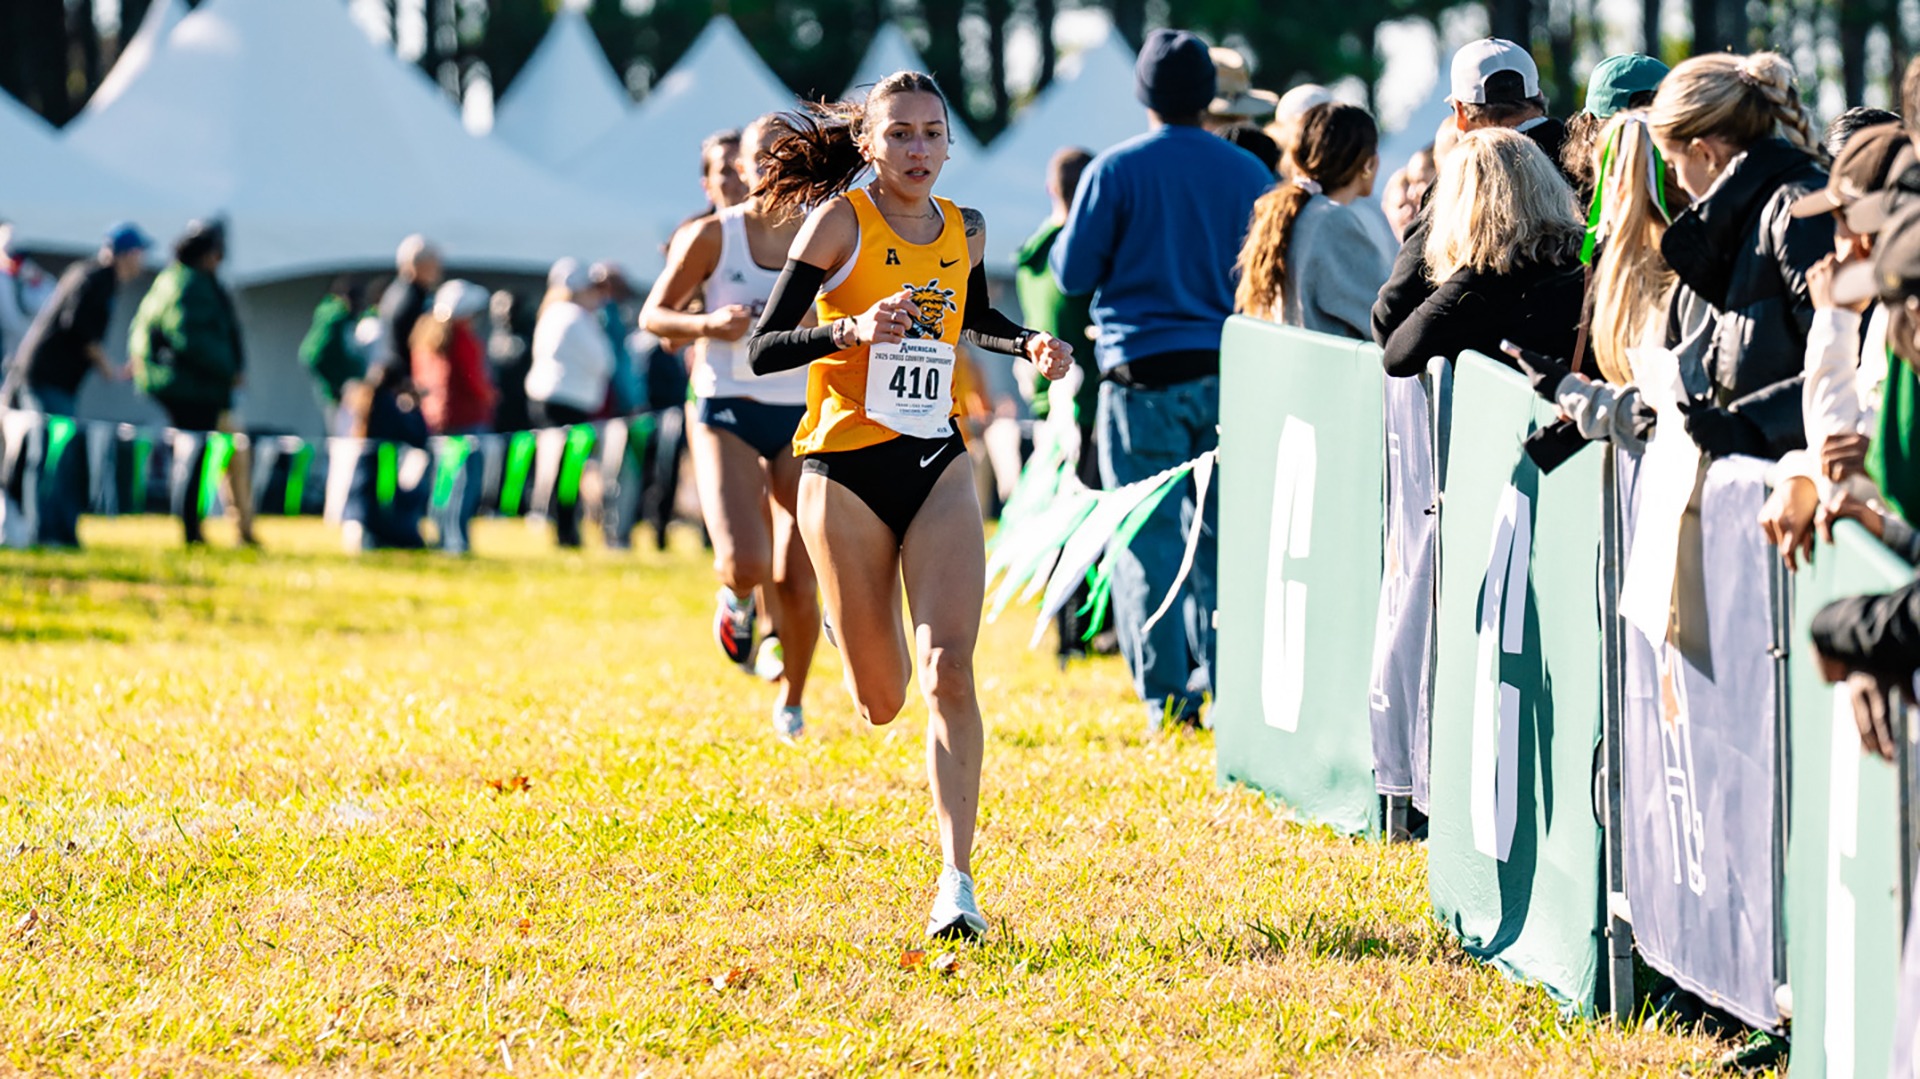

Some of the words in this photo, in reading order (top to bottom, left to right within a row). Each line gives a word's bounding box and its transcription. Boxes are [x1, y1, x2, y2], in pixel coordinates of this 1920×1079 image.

[900, 343, 937, 354] AMERICAN
[889, 353, 905, 362] CROSS
[905, 355, 925, 363] COUNTRY
[889, 366, 939, 400] 410
